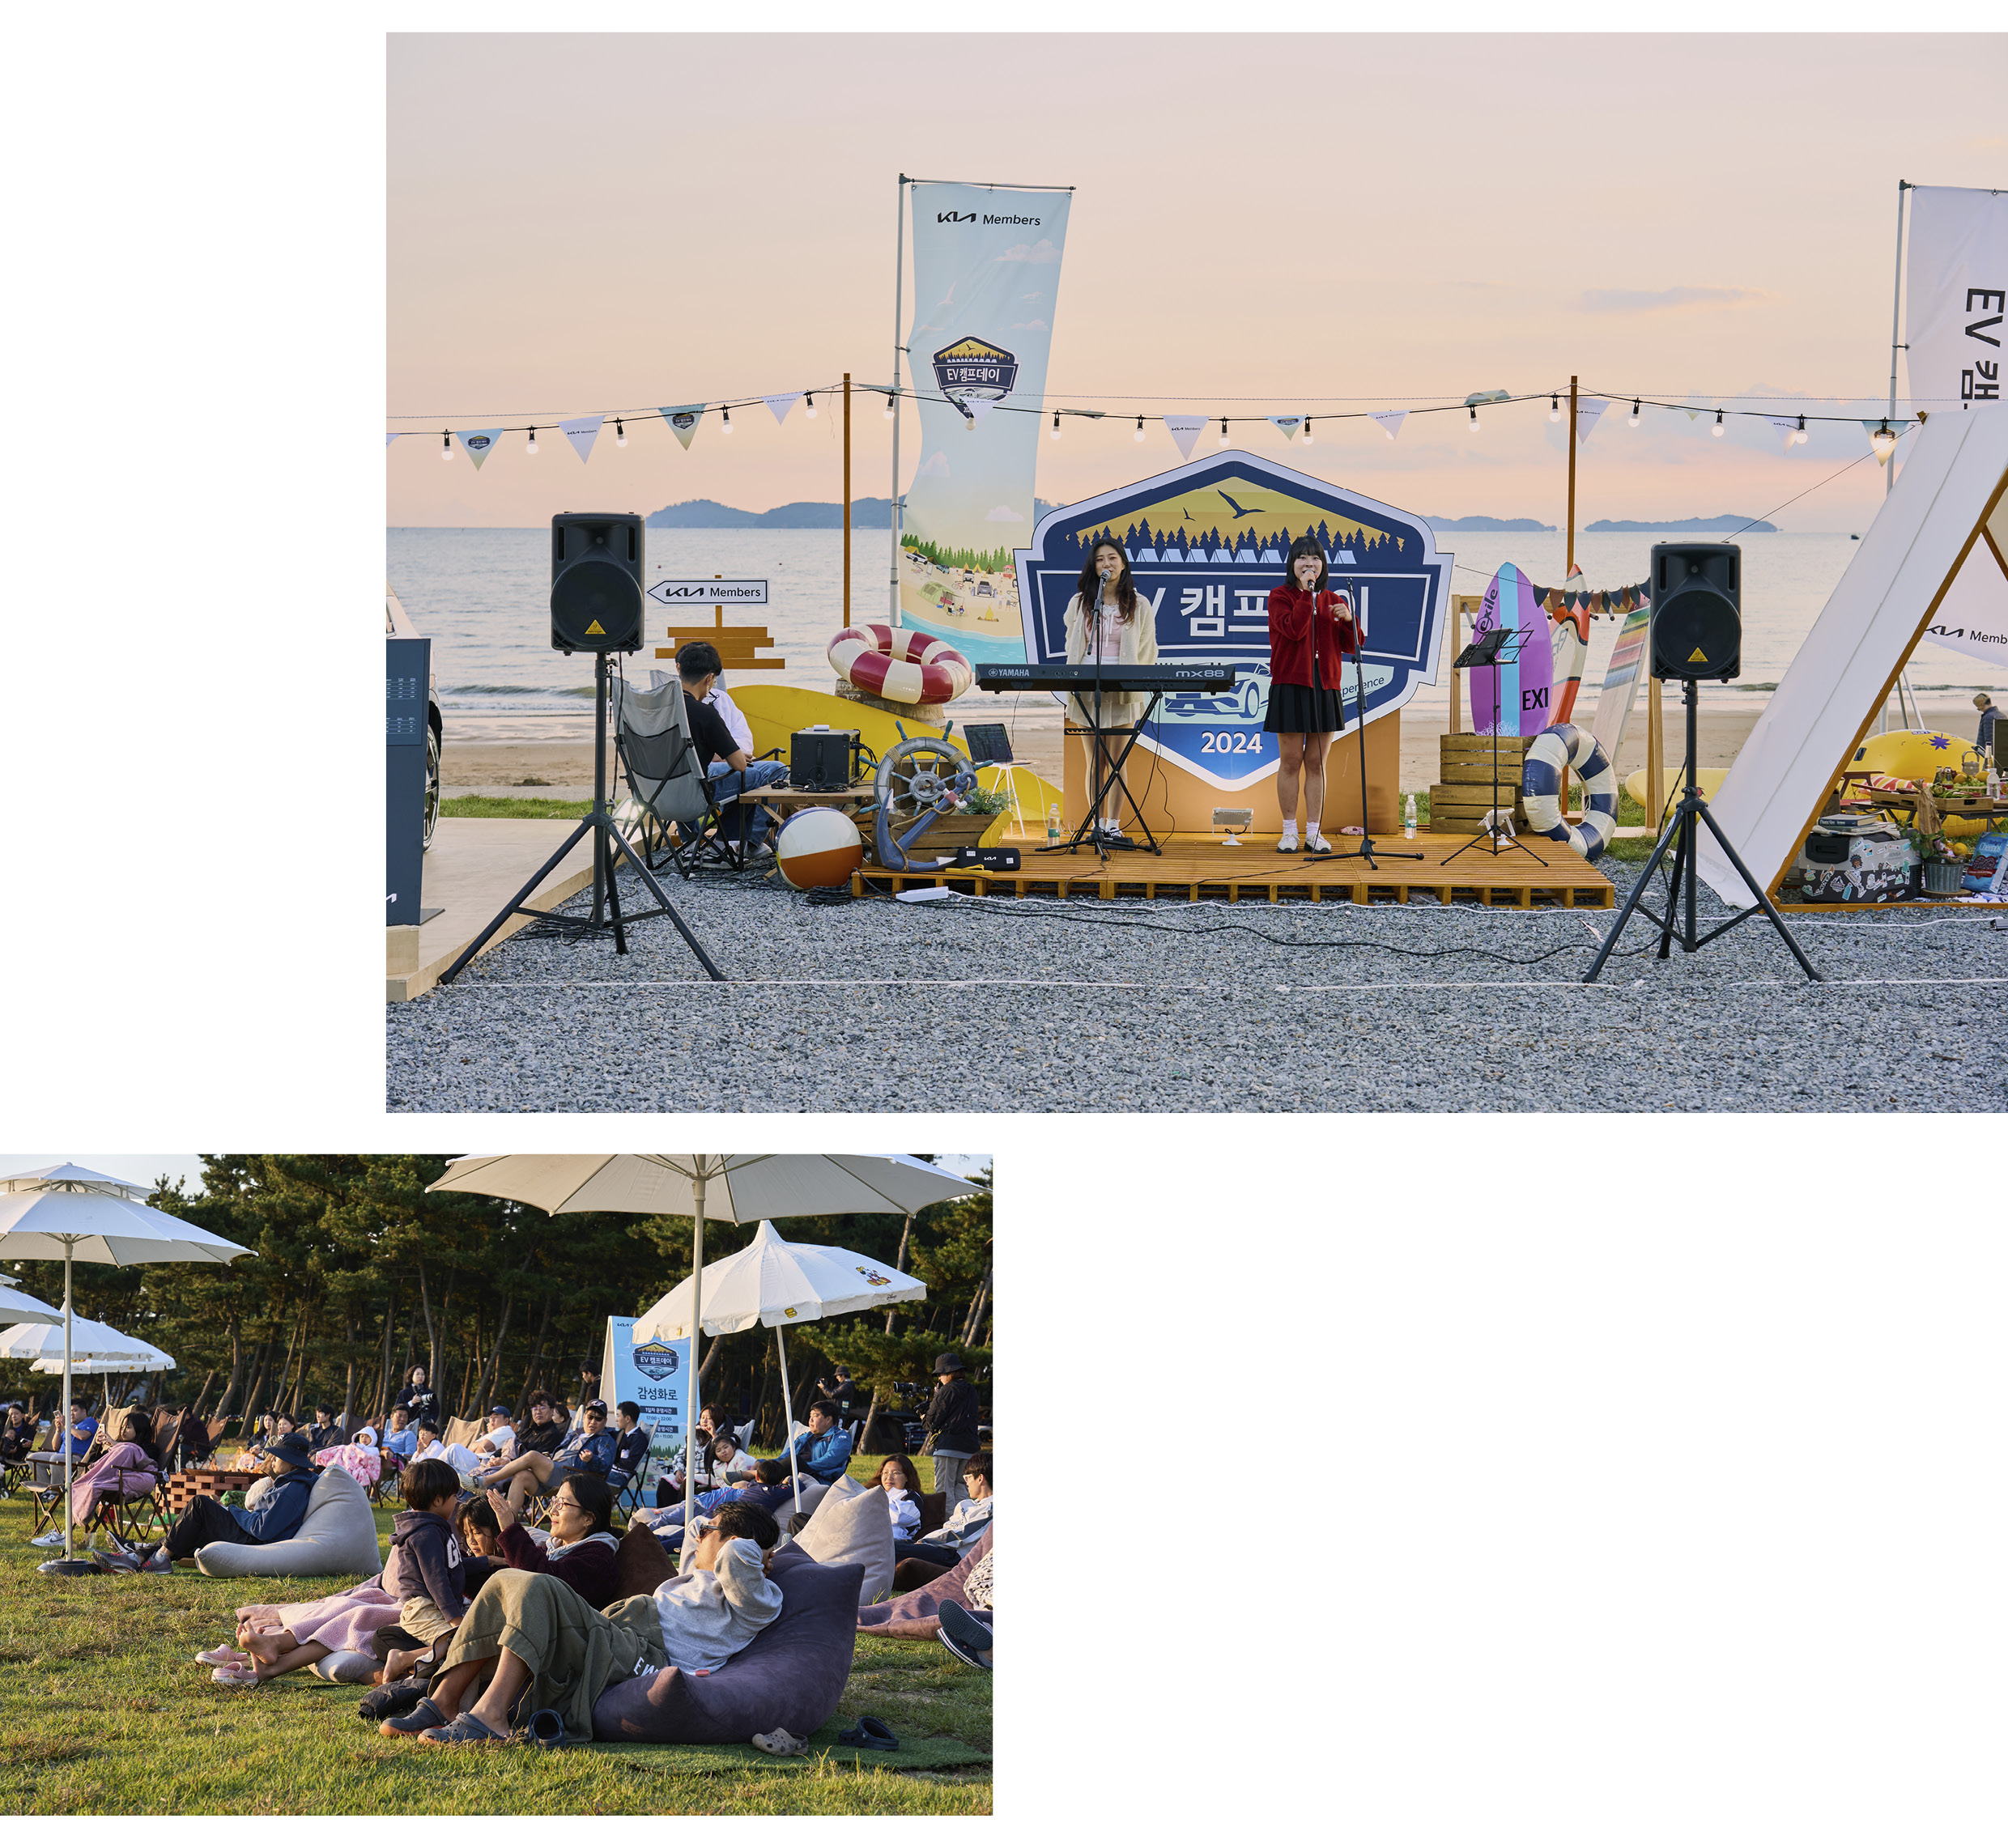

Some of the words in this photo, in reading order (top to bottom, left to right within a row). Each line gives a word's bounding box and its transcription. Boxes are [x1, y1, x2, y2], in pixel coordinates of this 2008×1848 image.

[982, 214, 1041, 226] Members
[1965, 288, 2006, 348] EV
[1961, 360, 1999, 410] 캠
[709, 587, 761, 597] Members
[1181, 584, 1369, 637] 캠프이
[998, 669, 1030, 677] YAMAHA
[1201, 732, 1263, 754] 2024
[637, 1386, 679, 1400] 감성화로
